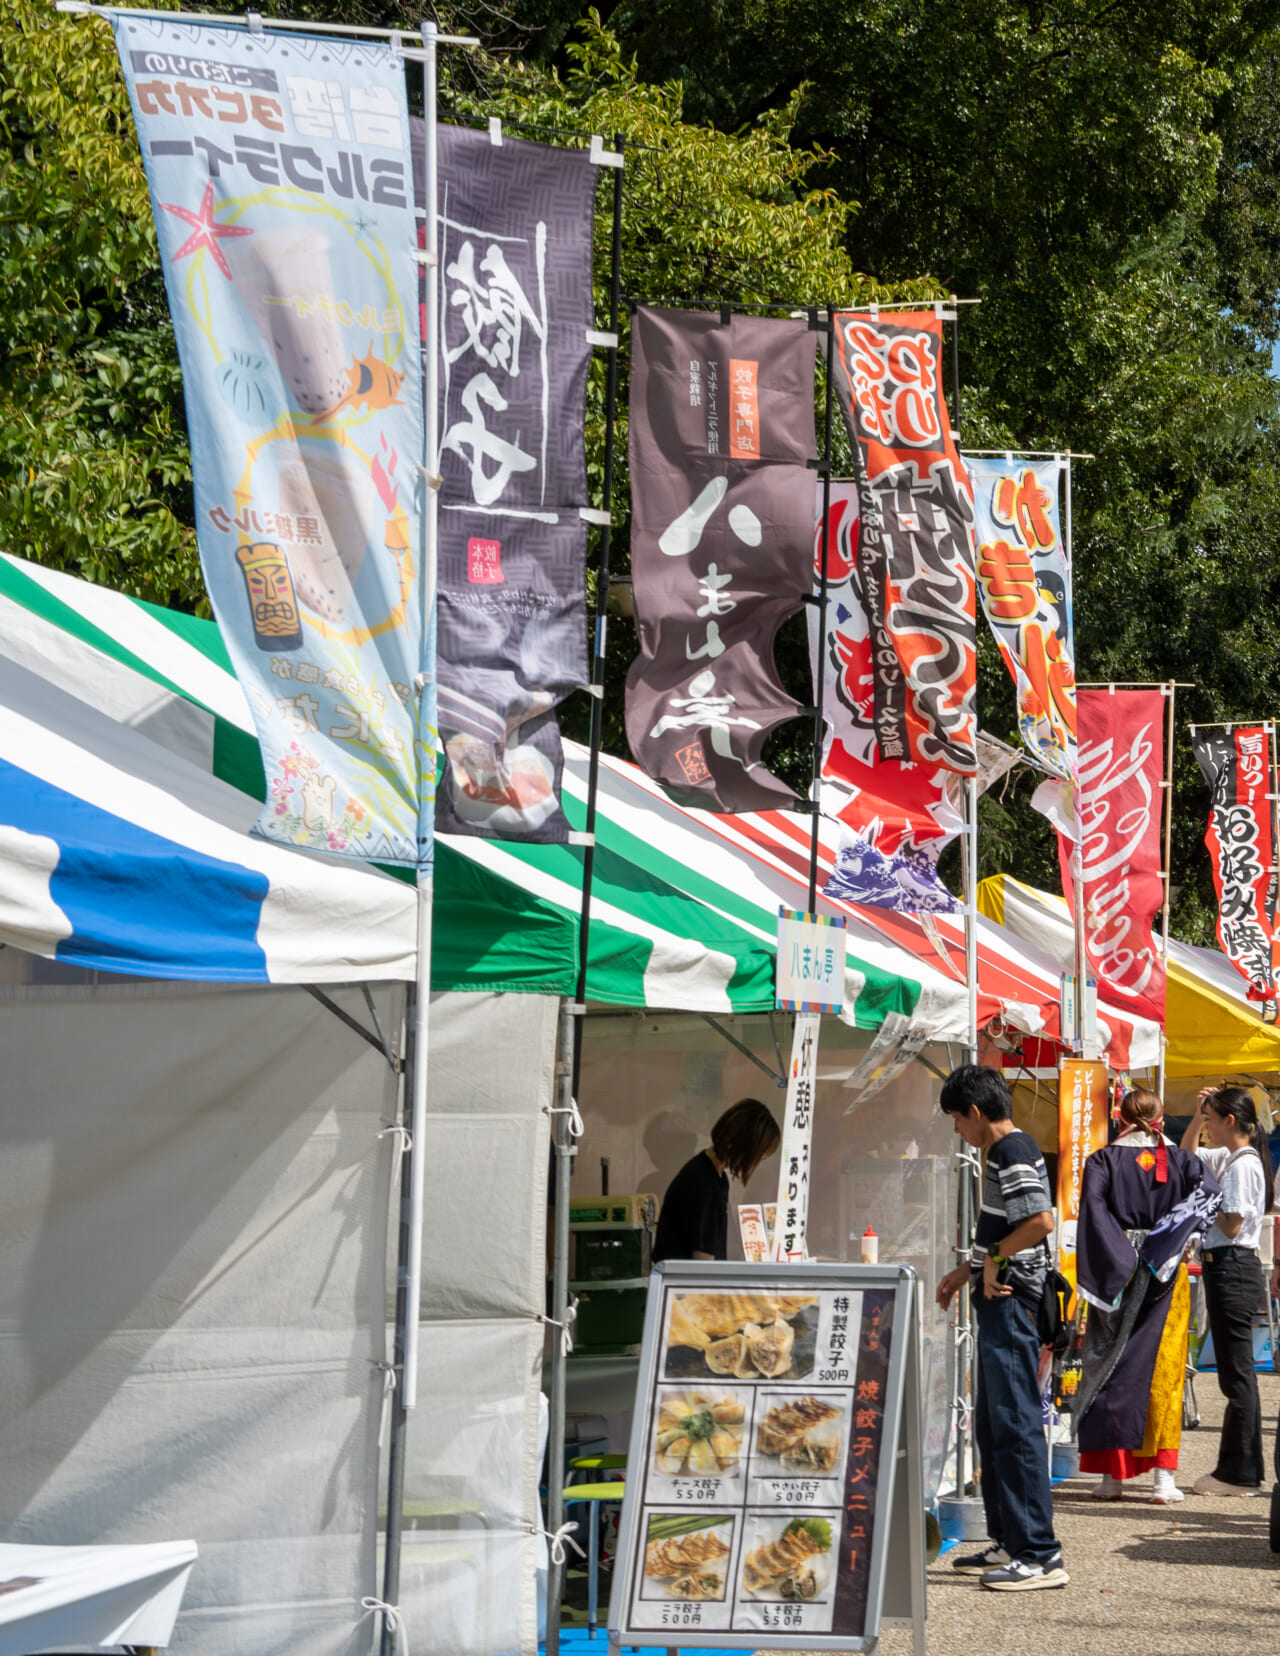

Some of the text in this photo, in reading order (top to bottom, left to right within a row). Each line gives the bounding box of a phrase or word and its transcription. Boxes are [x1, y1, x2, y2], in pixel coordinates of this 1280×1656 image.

[1213, 804, 1270, 992] お好み焼き
[790, 944, 834, 984] 八まん亭
[828, 1296, 850, 1368] 特製餃子
[817, 1369, 849, 1382] 500円
[847, 1378, 880, 1572] 焼餃子メニュー
[671, 1478, 724, 1490] チーズ餃子
[770, 1480, 822, 1491] やさい餃子
[675, 1488, 717, 1500] 550円
[775, 1491, 816, 1502] 500円
[661, 1603, 703, 1614] ニラ餃子
[762, 1604, 804, 1615] しそ餃子
[661, 1613, 702, 1625] 500円
[762, 1615, 803, 1626] 550円
